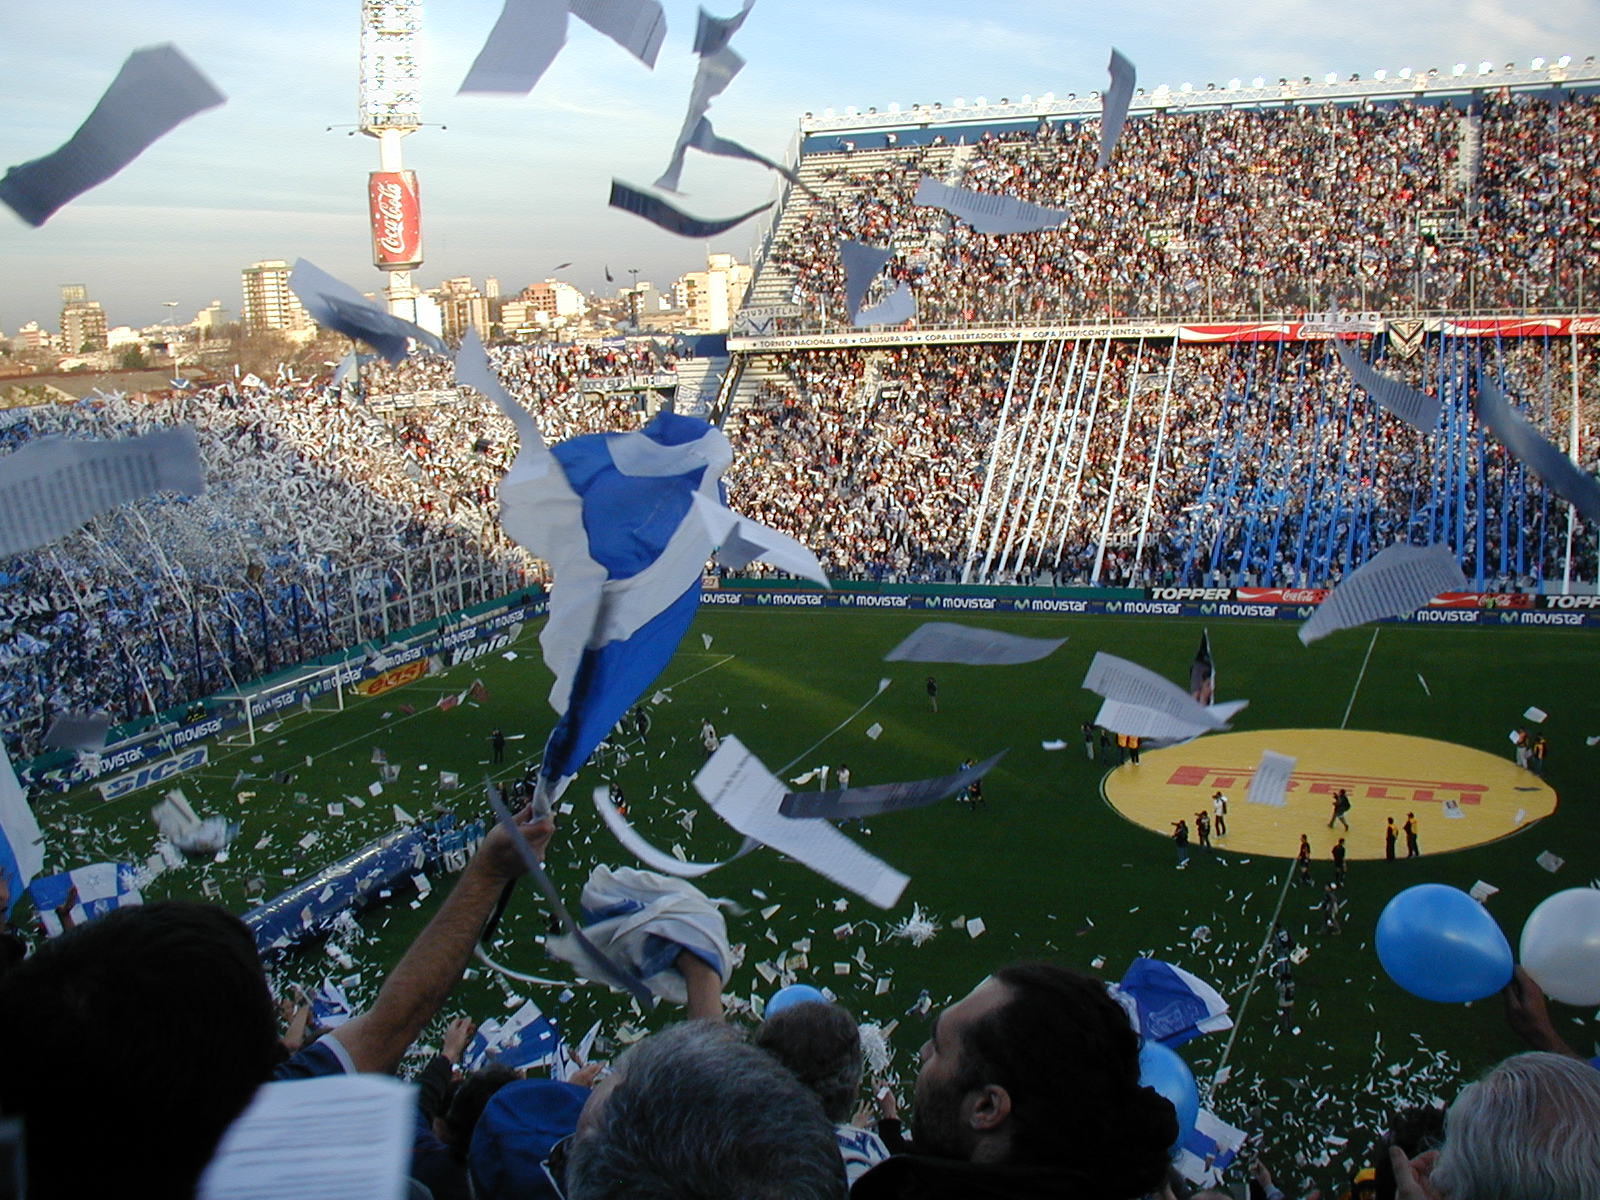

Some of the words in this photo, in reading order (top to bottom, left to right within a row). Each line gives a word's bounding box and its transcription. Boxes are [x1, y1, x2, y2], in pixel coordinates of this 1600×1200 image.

[859, 335, 901, 344] CLAUSURA
[949, 332, 1008, 340] LIBERTADORES
[773, 594, 823, 605] movistar
[1152, 587, 1231, 601] TOPPER
[856, 595, 908, 607] movistar
[943, 598, 997, 609] movistar
[1032, 599, 1088, 612] movistar
[1124, 601, 1182, 614] movistar
[1219, 604, 1279, 617] movistar
[1417, 609, 1480, 622] movistar
[1521, 612, 1585, 625] movistar
[174, 718, 223, 743] movistar
[100, 746, 145, 773] ovistar
